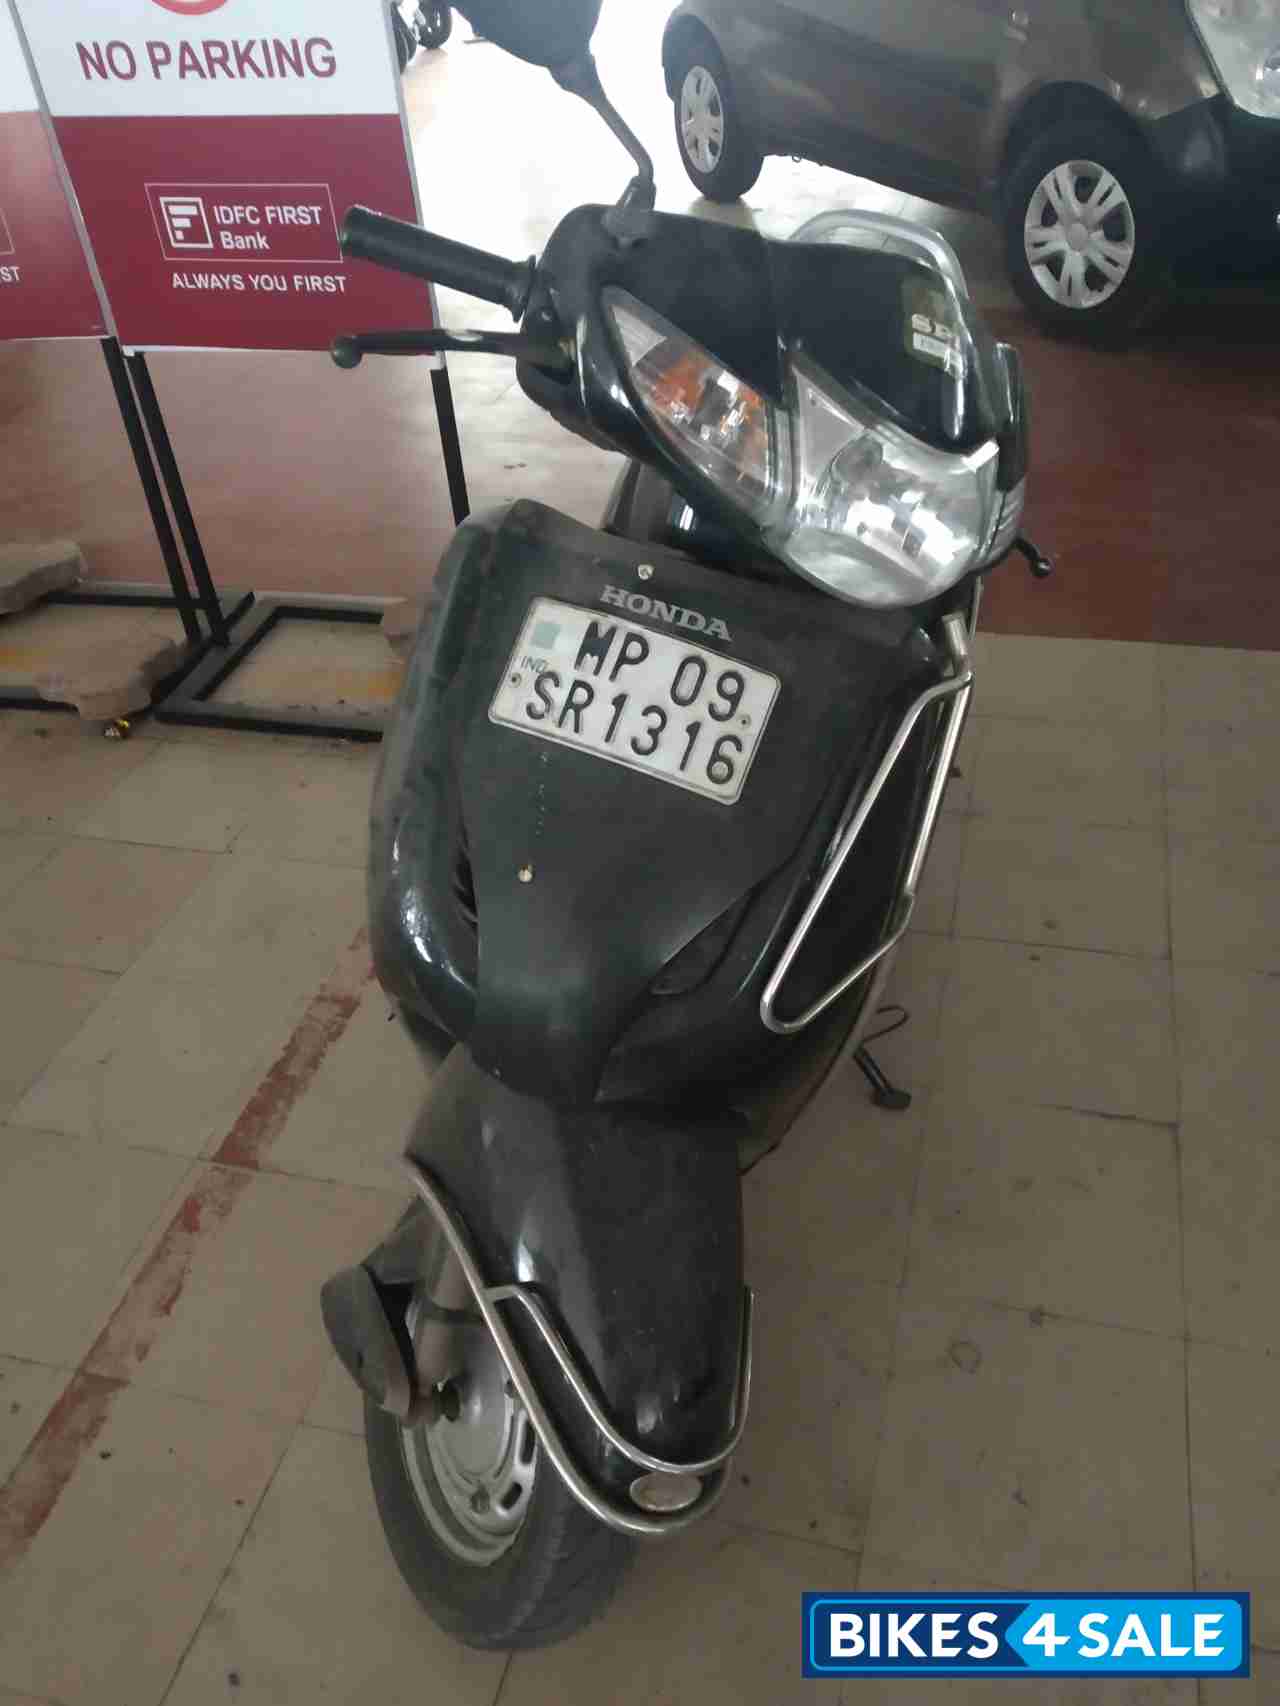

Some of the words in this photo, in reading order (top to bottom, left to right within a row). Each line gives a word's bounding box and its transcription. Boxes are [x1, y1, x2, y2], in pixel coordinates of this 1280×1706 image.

[75, 41, 137, 80] NO
[145, 37, 337, 80] PARKING
[213, 205, 261, 226] IDFC
[265, 205, 322, 226] FIRST
[218, 231, 271, 251] Bank
[0, 266, 21, 283] ST
[172, 272, 245, 291] ALWAYS
[248, 274, 288, 292] YOU
[293, 274, 347, 294] FIRST
[600, 584, 733, 643] HONDA
[574, 620, 650, 682] MP
[670, 654, 745, 722] 09
[525, 671, 743, 785] SR1316
